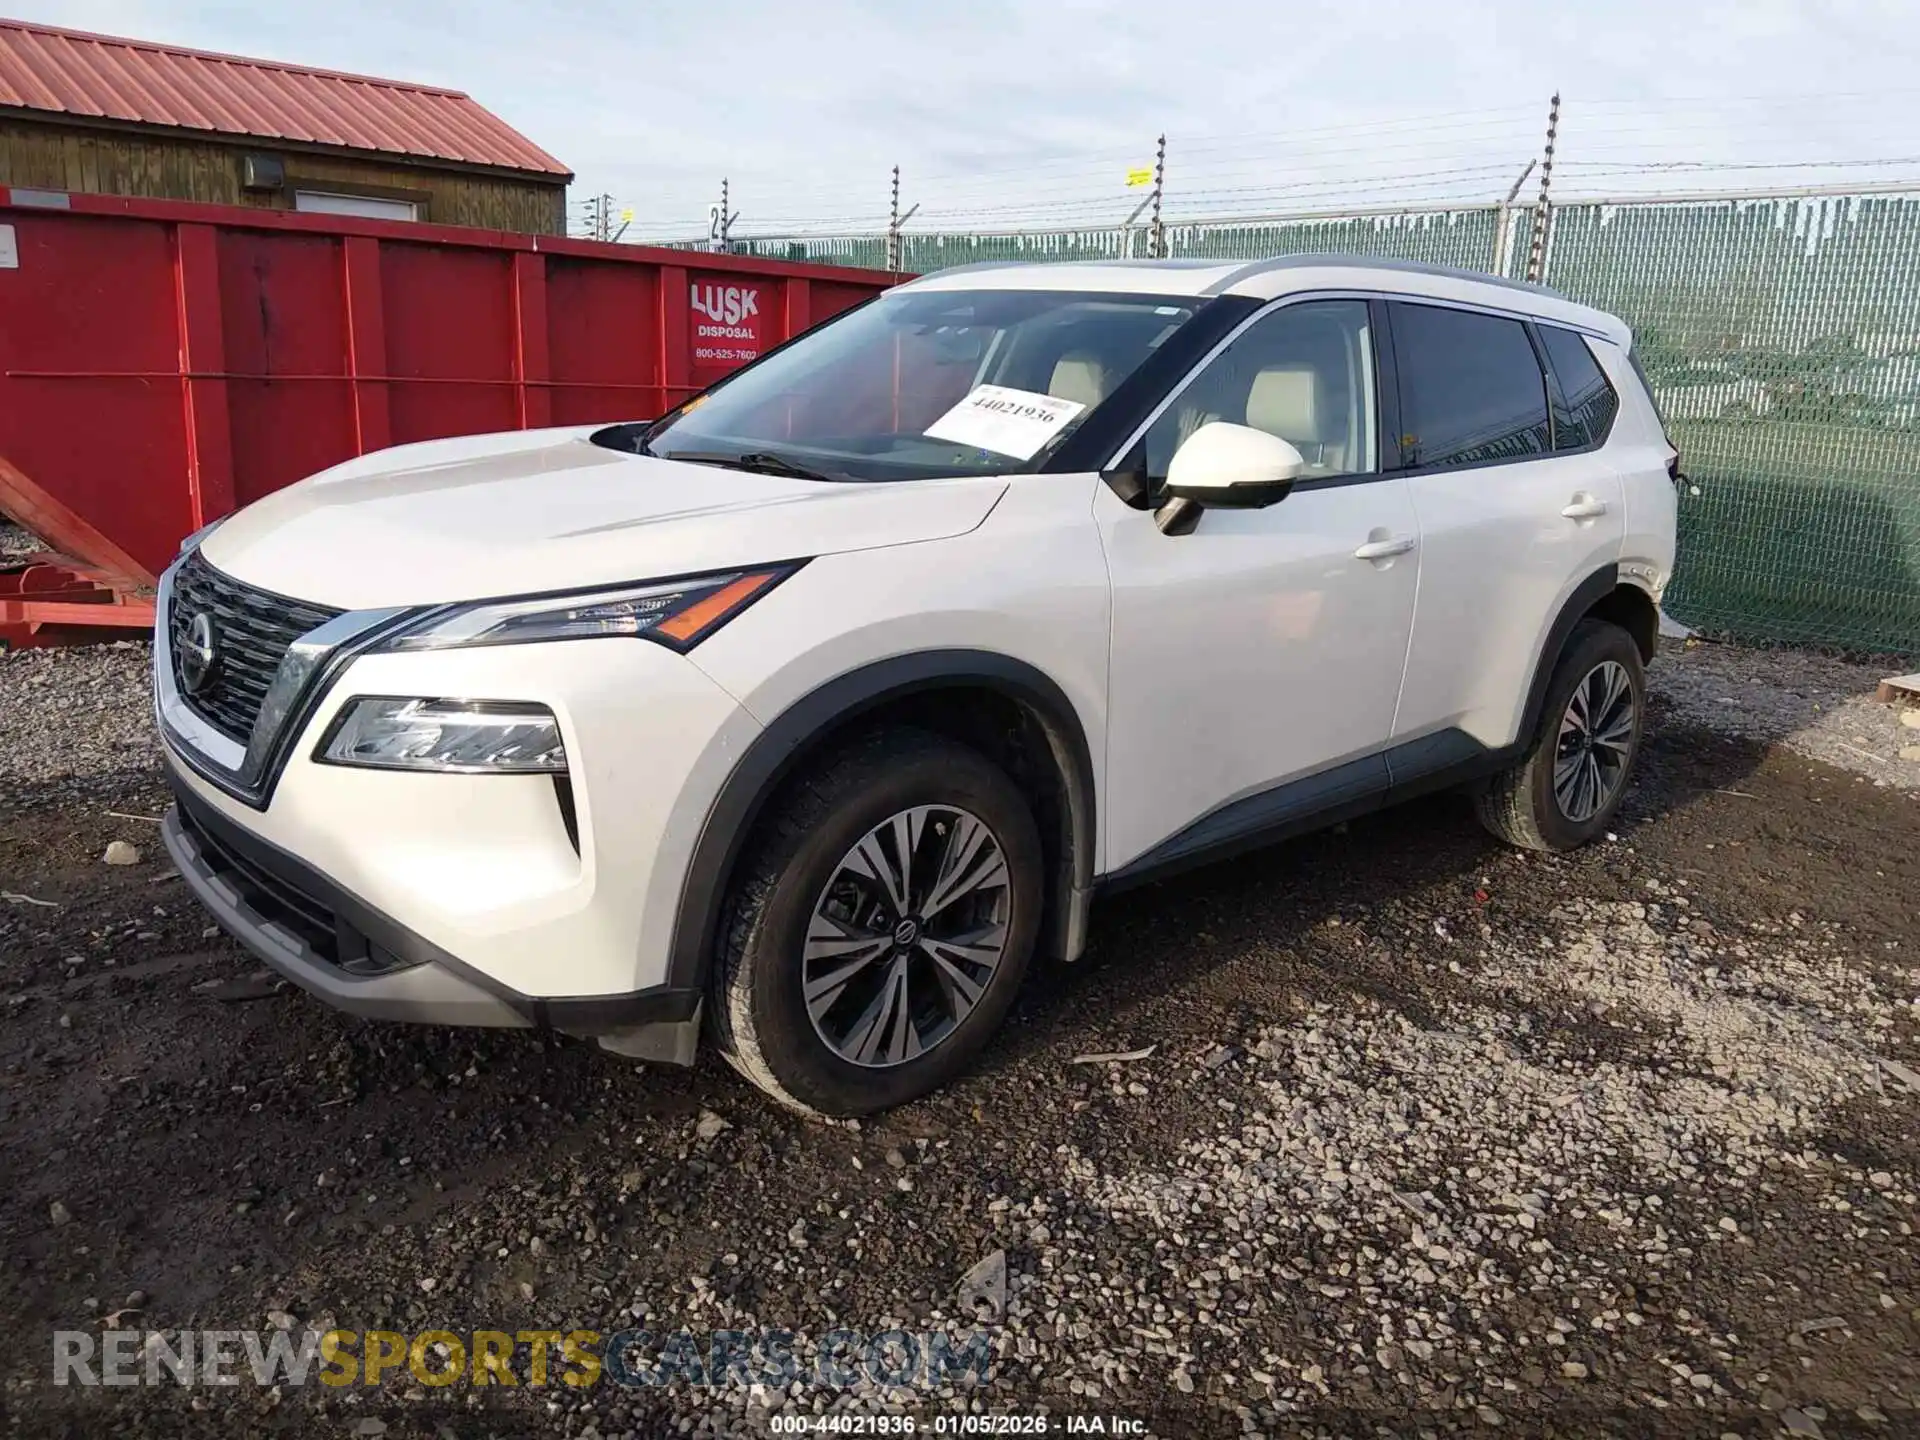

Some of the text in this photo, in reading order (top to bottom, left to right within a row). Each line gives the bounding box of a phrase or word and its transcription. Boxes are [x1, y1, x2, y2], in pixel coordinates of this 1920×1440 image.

[691, 284, 759, 325] LUSK
[698, 325, 756, 339] DISPOSAL
[696, 348, 757, 360] 800-525-7602
[972, 398, 1055, 422] 44021936
